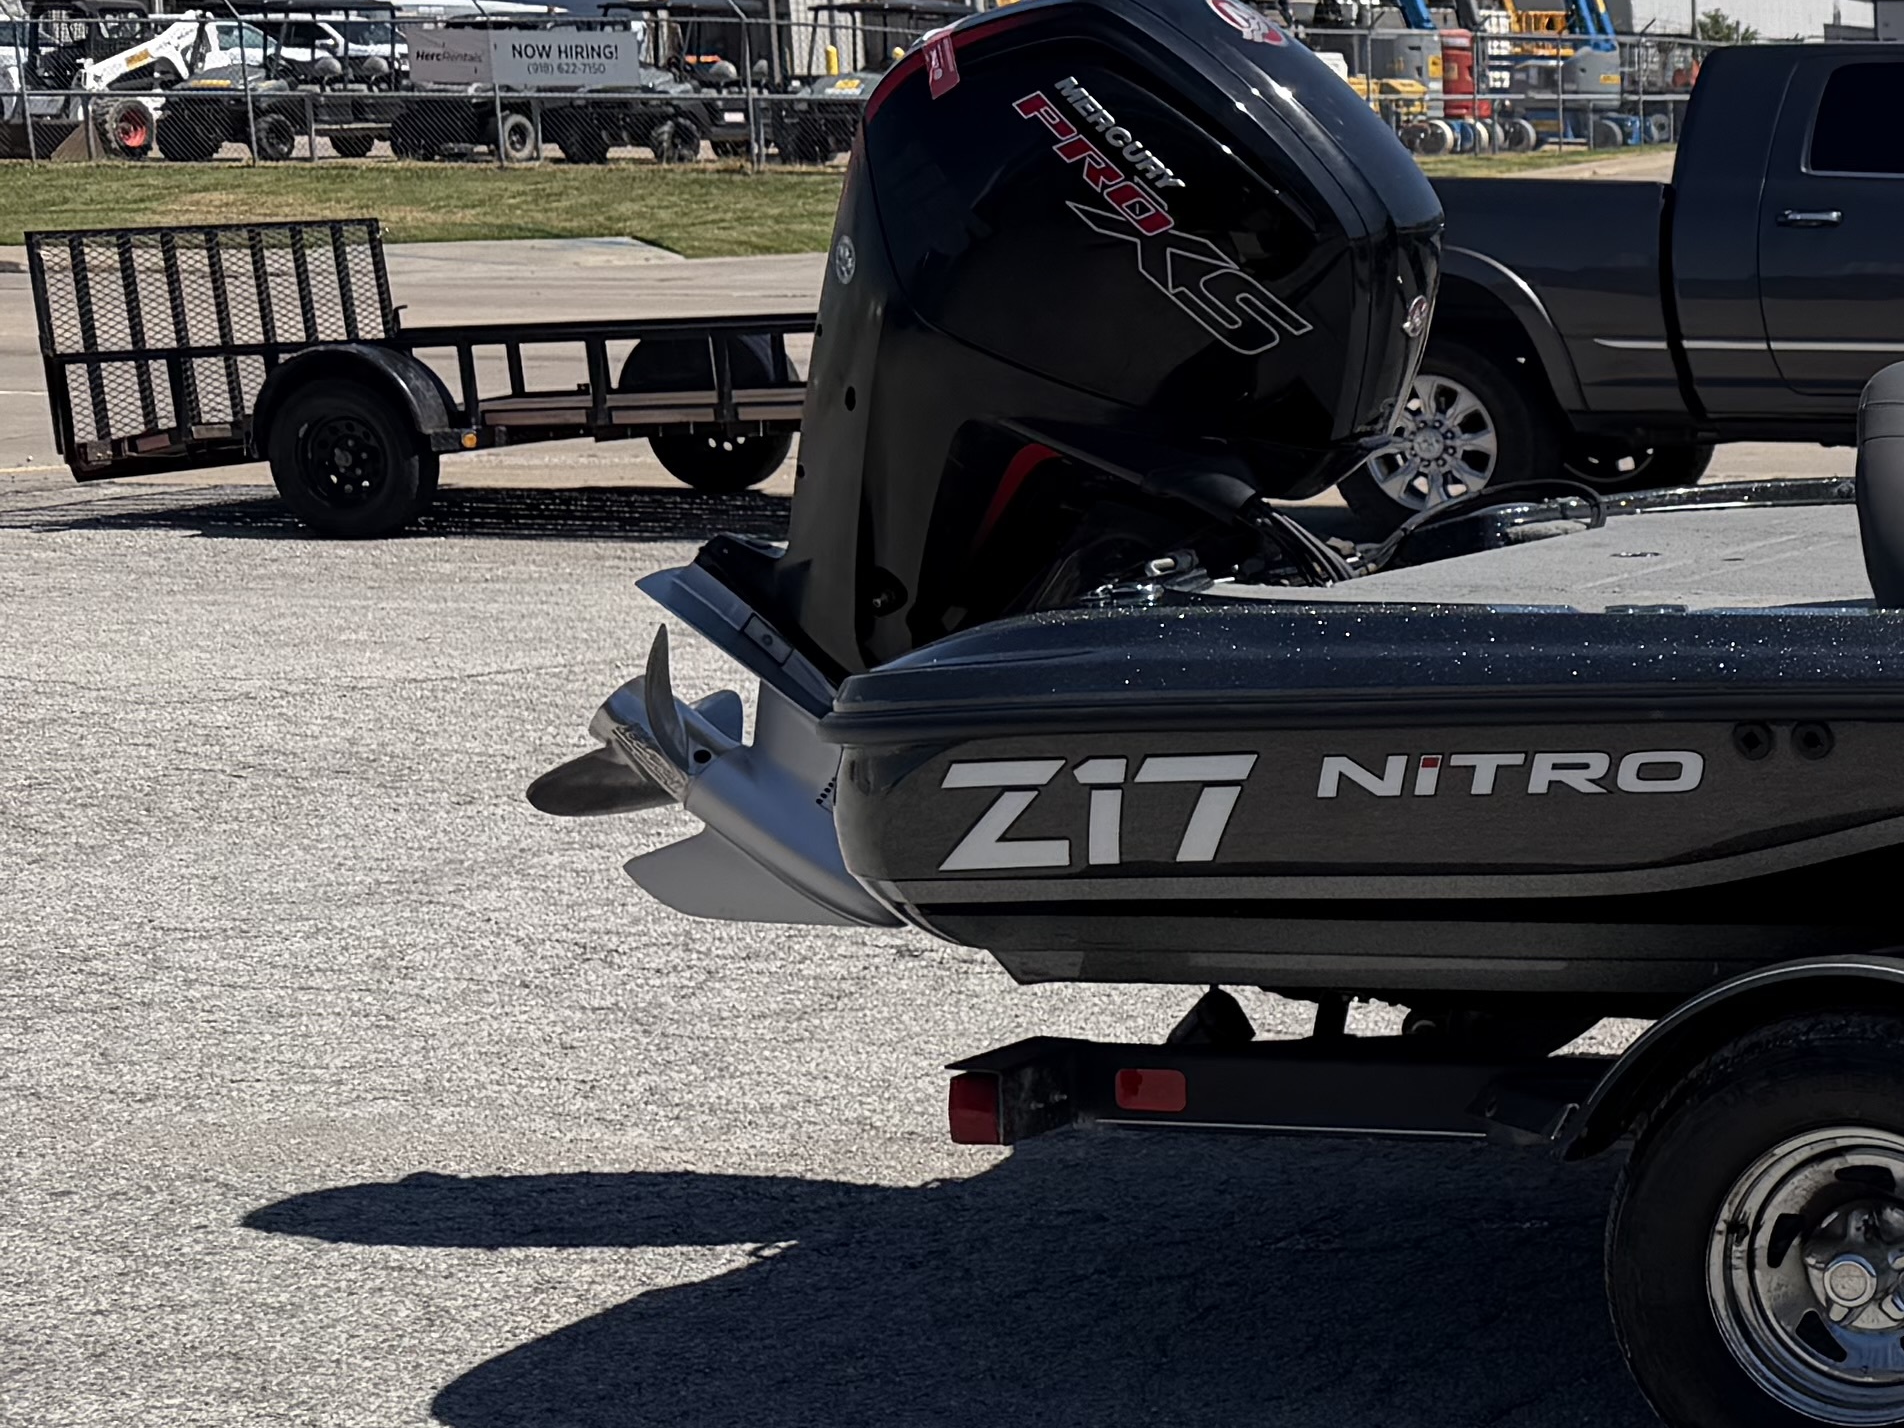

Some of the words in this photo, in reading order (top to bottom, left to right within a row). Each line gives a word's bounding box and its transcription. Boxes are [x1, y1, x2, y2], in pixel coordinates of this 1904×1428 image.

[512, 44, 551, 60] NOW
[558, 44, 619, 60] HIRING!
[1012, 90, 1175, 236] PRO
[1054, 76, 1186, 188] MERCURY
[1065, 199, 1314, 355] XS
[938, 753, 1258, 870] Z17
